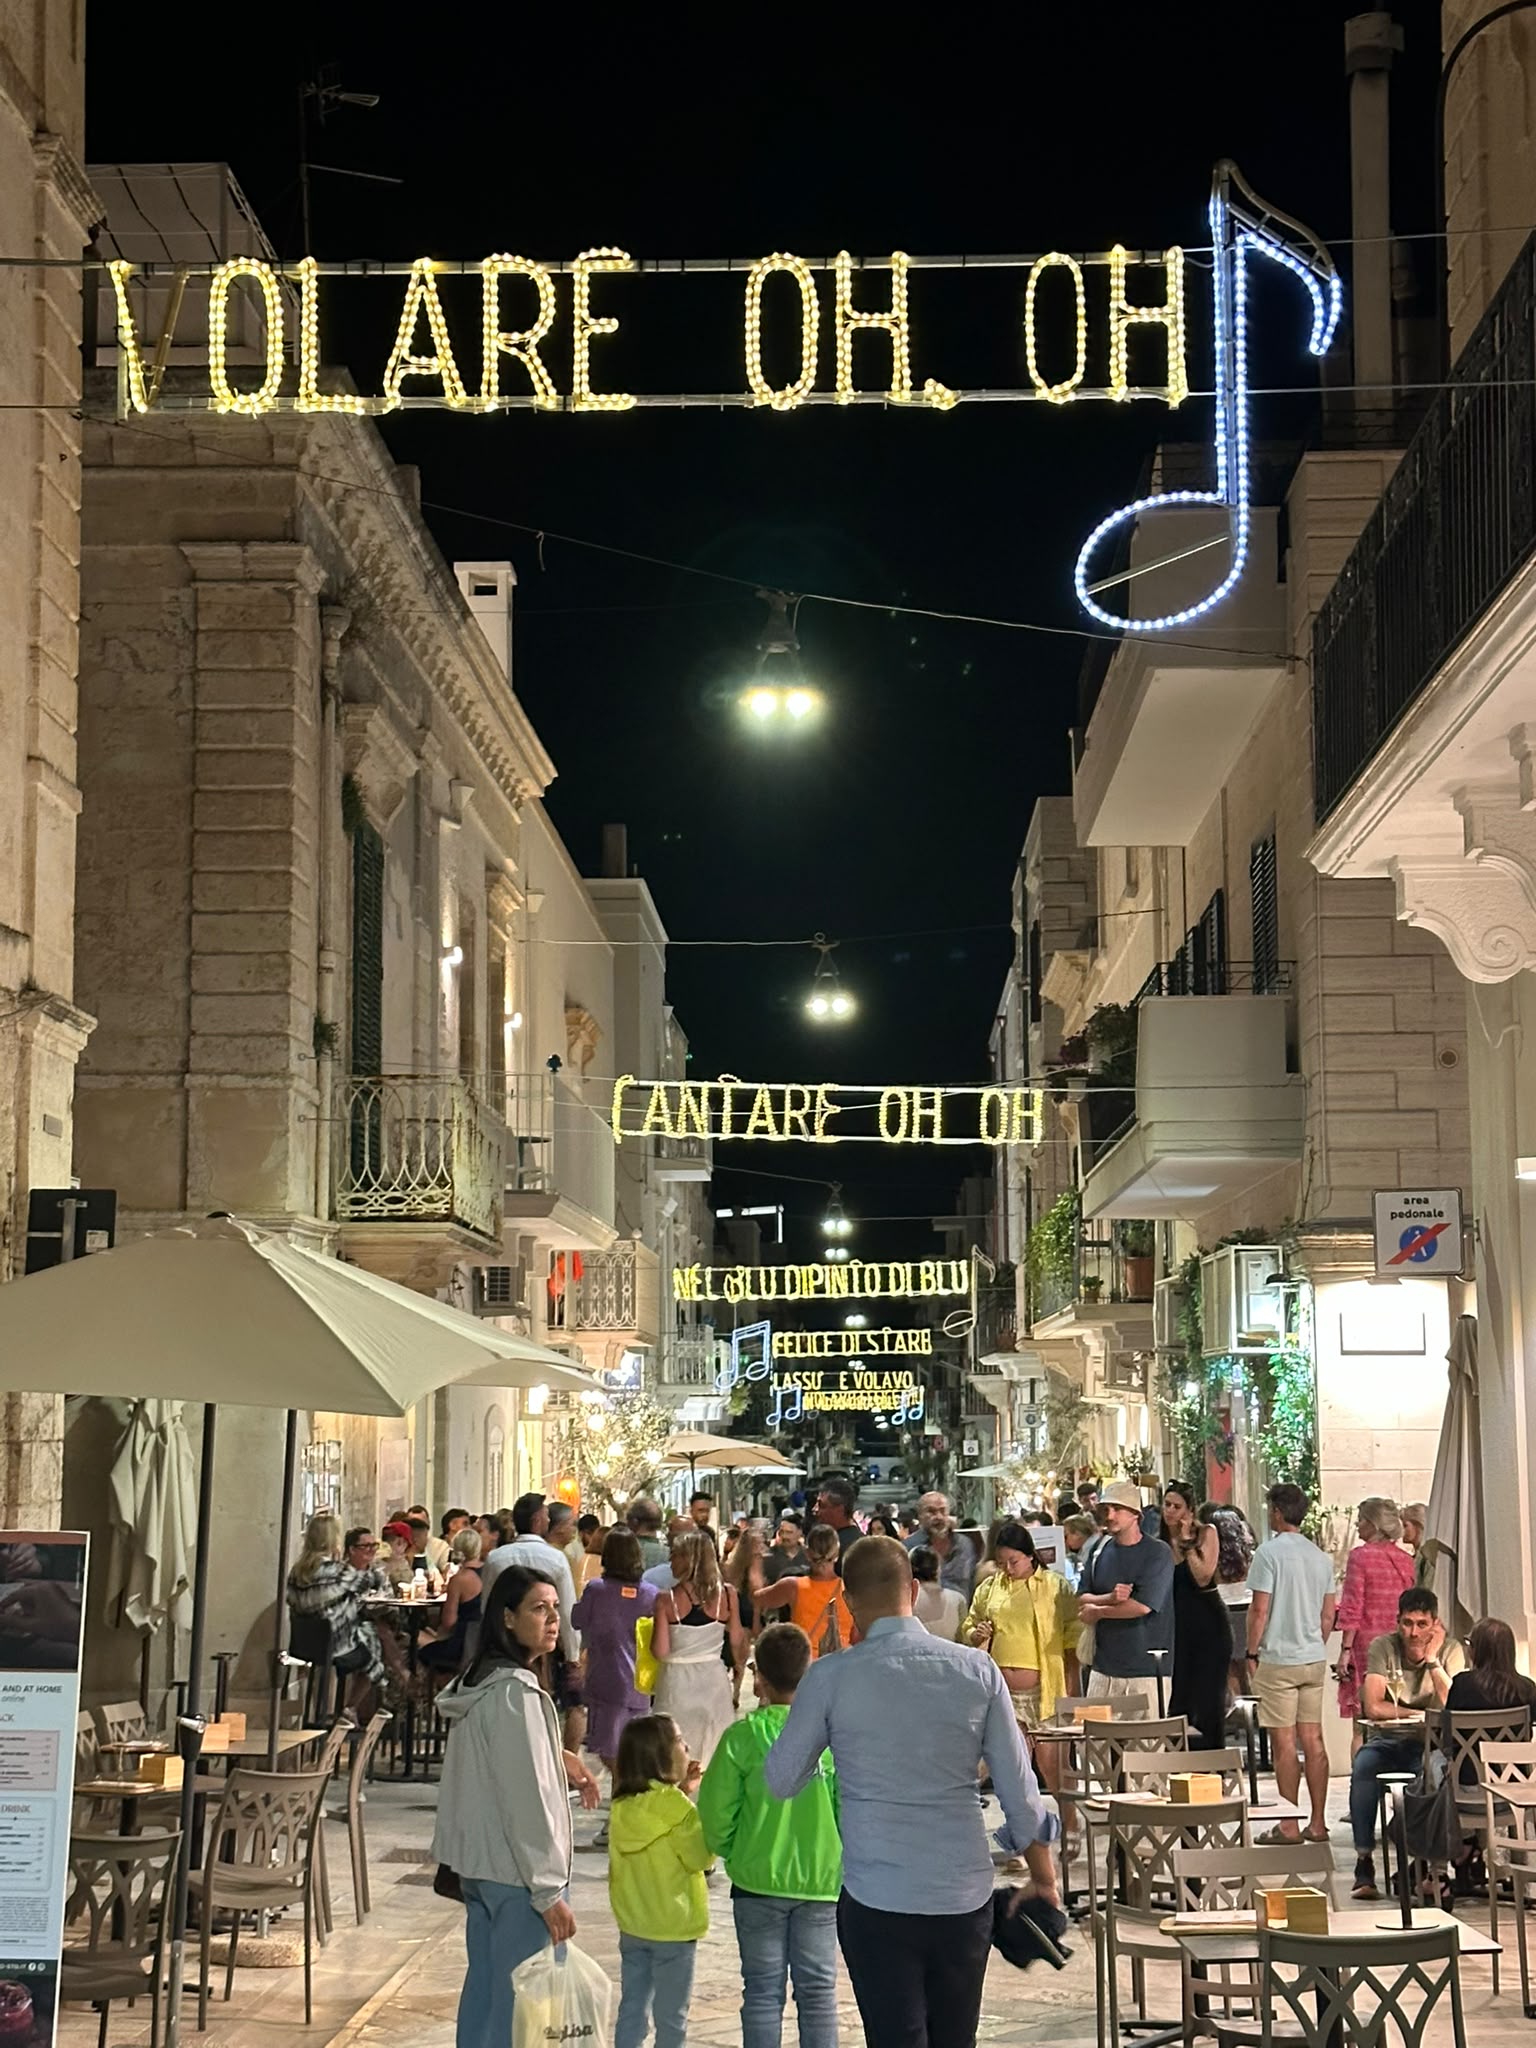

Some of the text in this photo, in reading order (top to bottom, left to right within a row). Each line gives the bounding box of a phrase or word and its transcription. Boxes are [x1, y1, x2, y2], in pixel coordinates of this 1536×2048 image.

[109, 247, 638, 414] VOLARE
[1025, 244, 1189, 408] OH
[612, 1074, 1043, 1148] CANTARE OH OH
[1403, 1197, 1430, 1205] area
[1390, 1208, 1445, 1220] pedonale
[672, 1259, 969, 1304] NEL BLU DIPINTO DI BLU
[772, 1332, 833, 1359] FELICE
[841, 1331, 860, 1356] DI
[839, 1370, 850, 1391] E
[853, 1370, 914, 1391] VOLAVO
[2, 1685, 63, 1694] AND AT HOME
